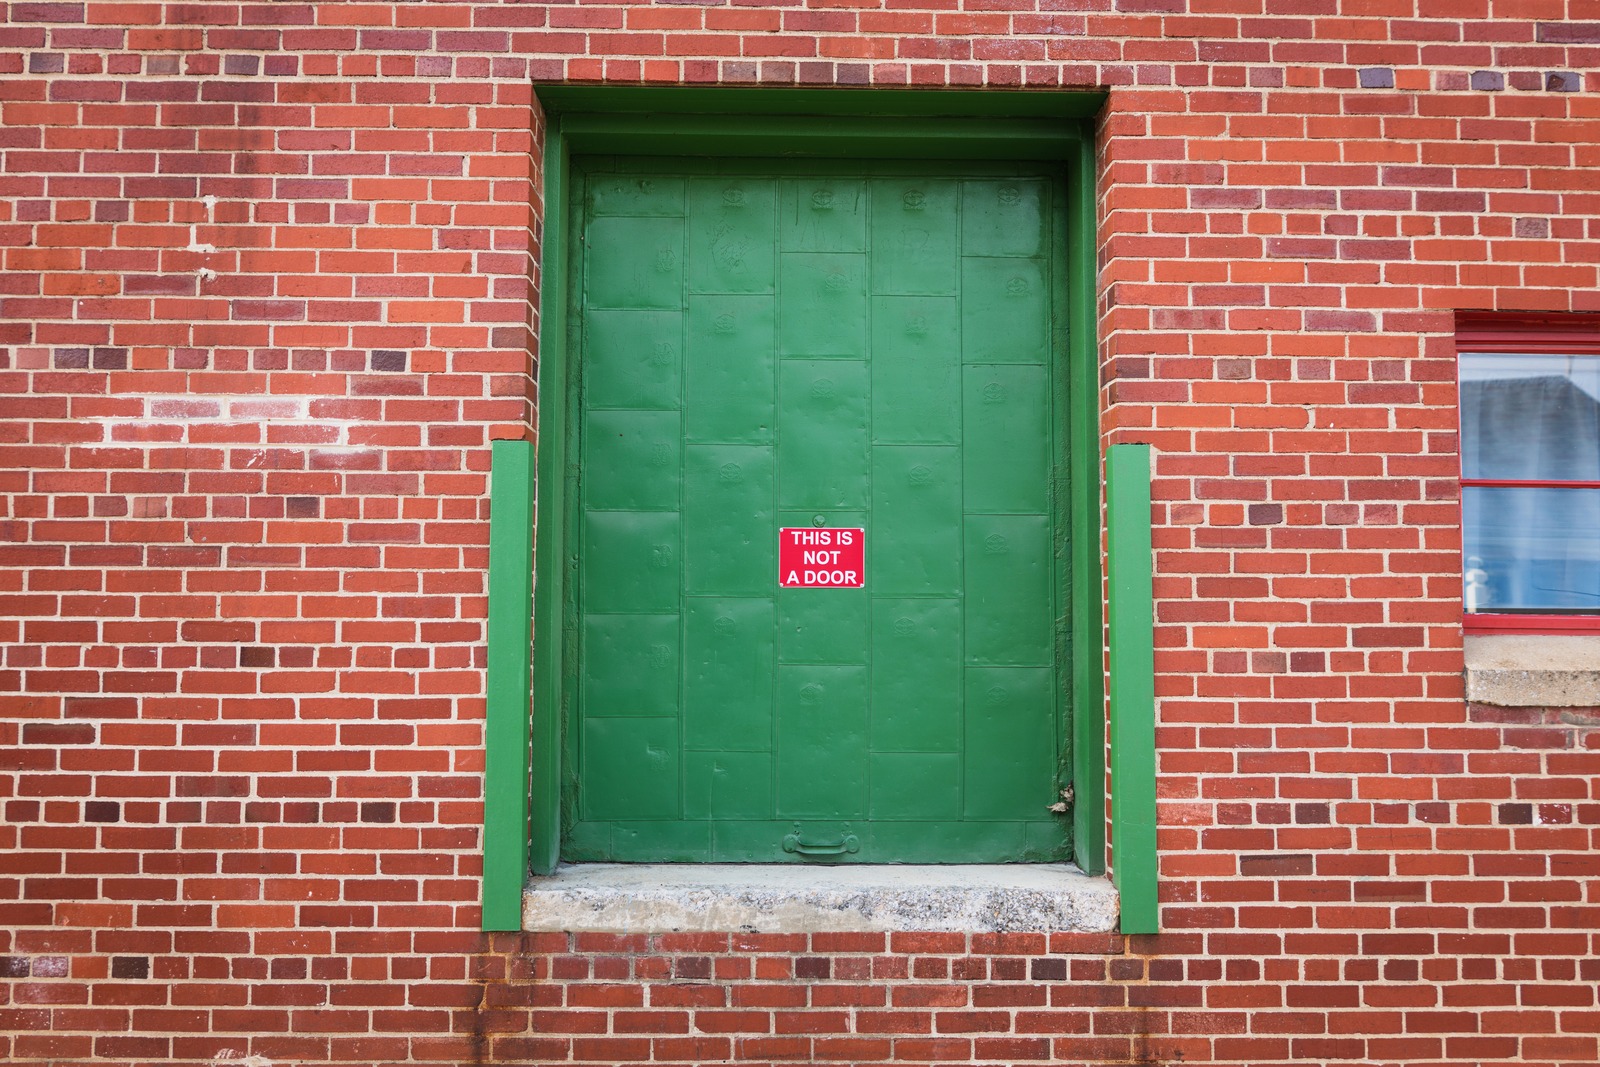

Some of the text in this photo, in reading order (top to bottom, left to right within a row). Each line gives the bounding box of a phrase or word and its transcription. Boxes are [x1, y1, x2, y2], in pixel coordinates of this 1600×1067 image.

[790, 531, 853, 546] THIS IS
[803, 550, 841, 565] NOT
[786, 570, 857, 584] A DOOR
